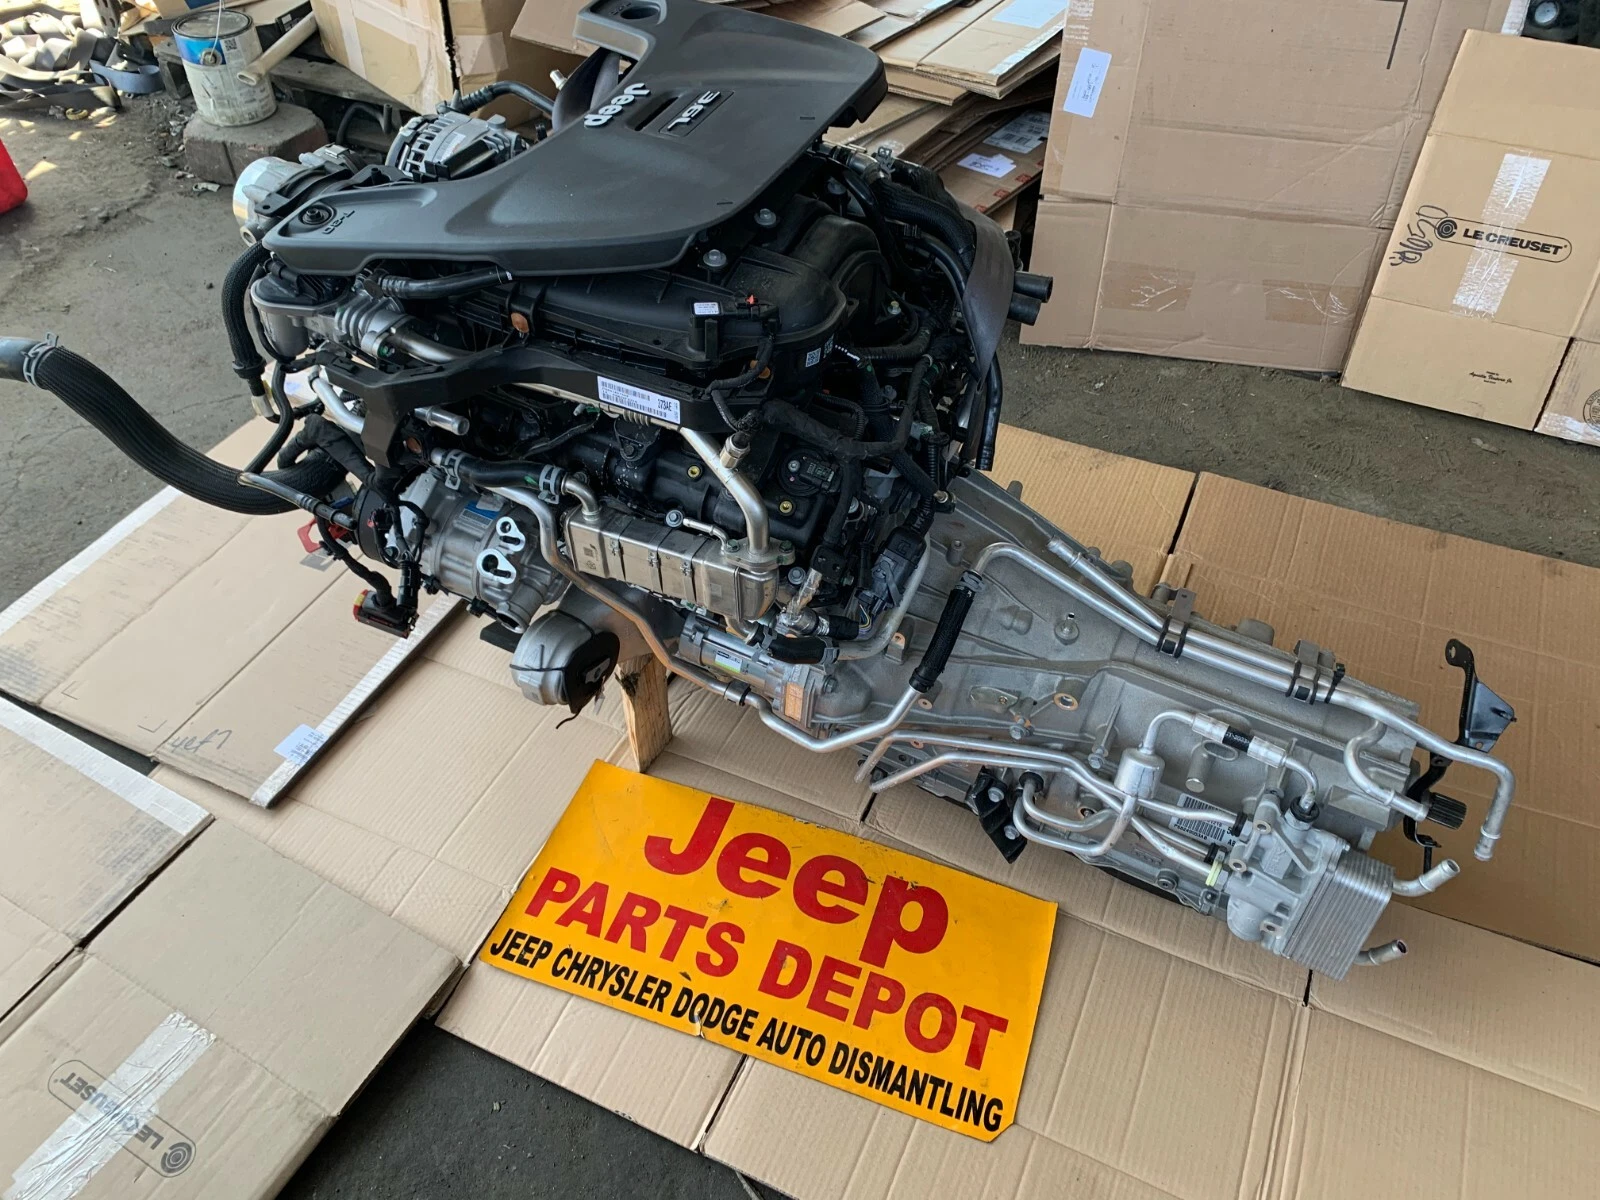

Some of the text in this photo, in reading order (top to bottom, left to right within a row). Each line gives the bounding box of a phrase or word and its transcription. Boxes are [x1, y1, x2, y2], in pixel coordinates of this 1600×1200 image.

[584, 82, 650, 127] Jeep
[1463, 228, 1563, 255] LE CREUSET
[644, 797, 948, 968] Jeep
[525, 867, 1009, 1070] PARTS DEPOT
[490, 928, 1004, 1132] JEEP CHRYSLER DODGE AUTO DISMANTLING
[135, 1124, 164, 1150] LE
